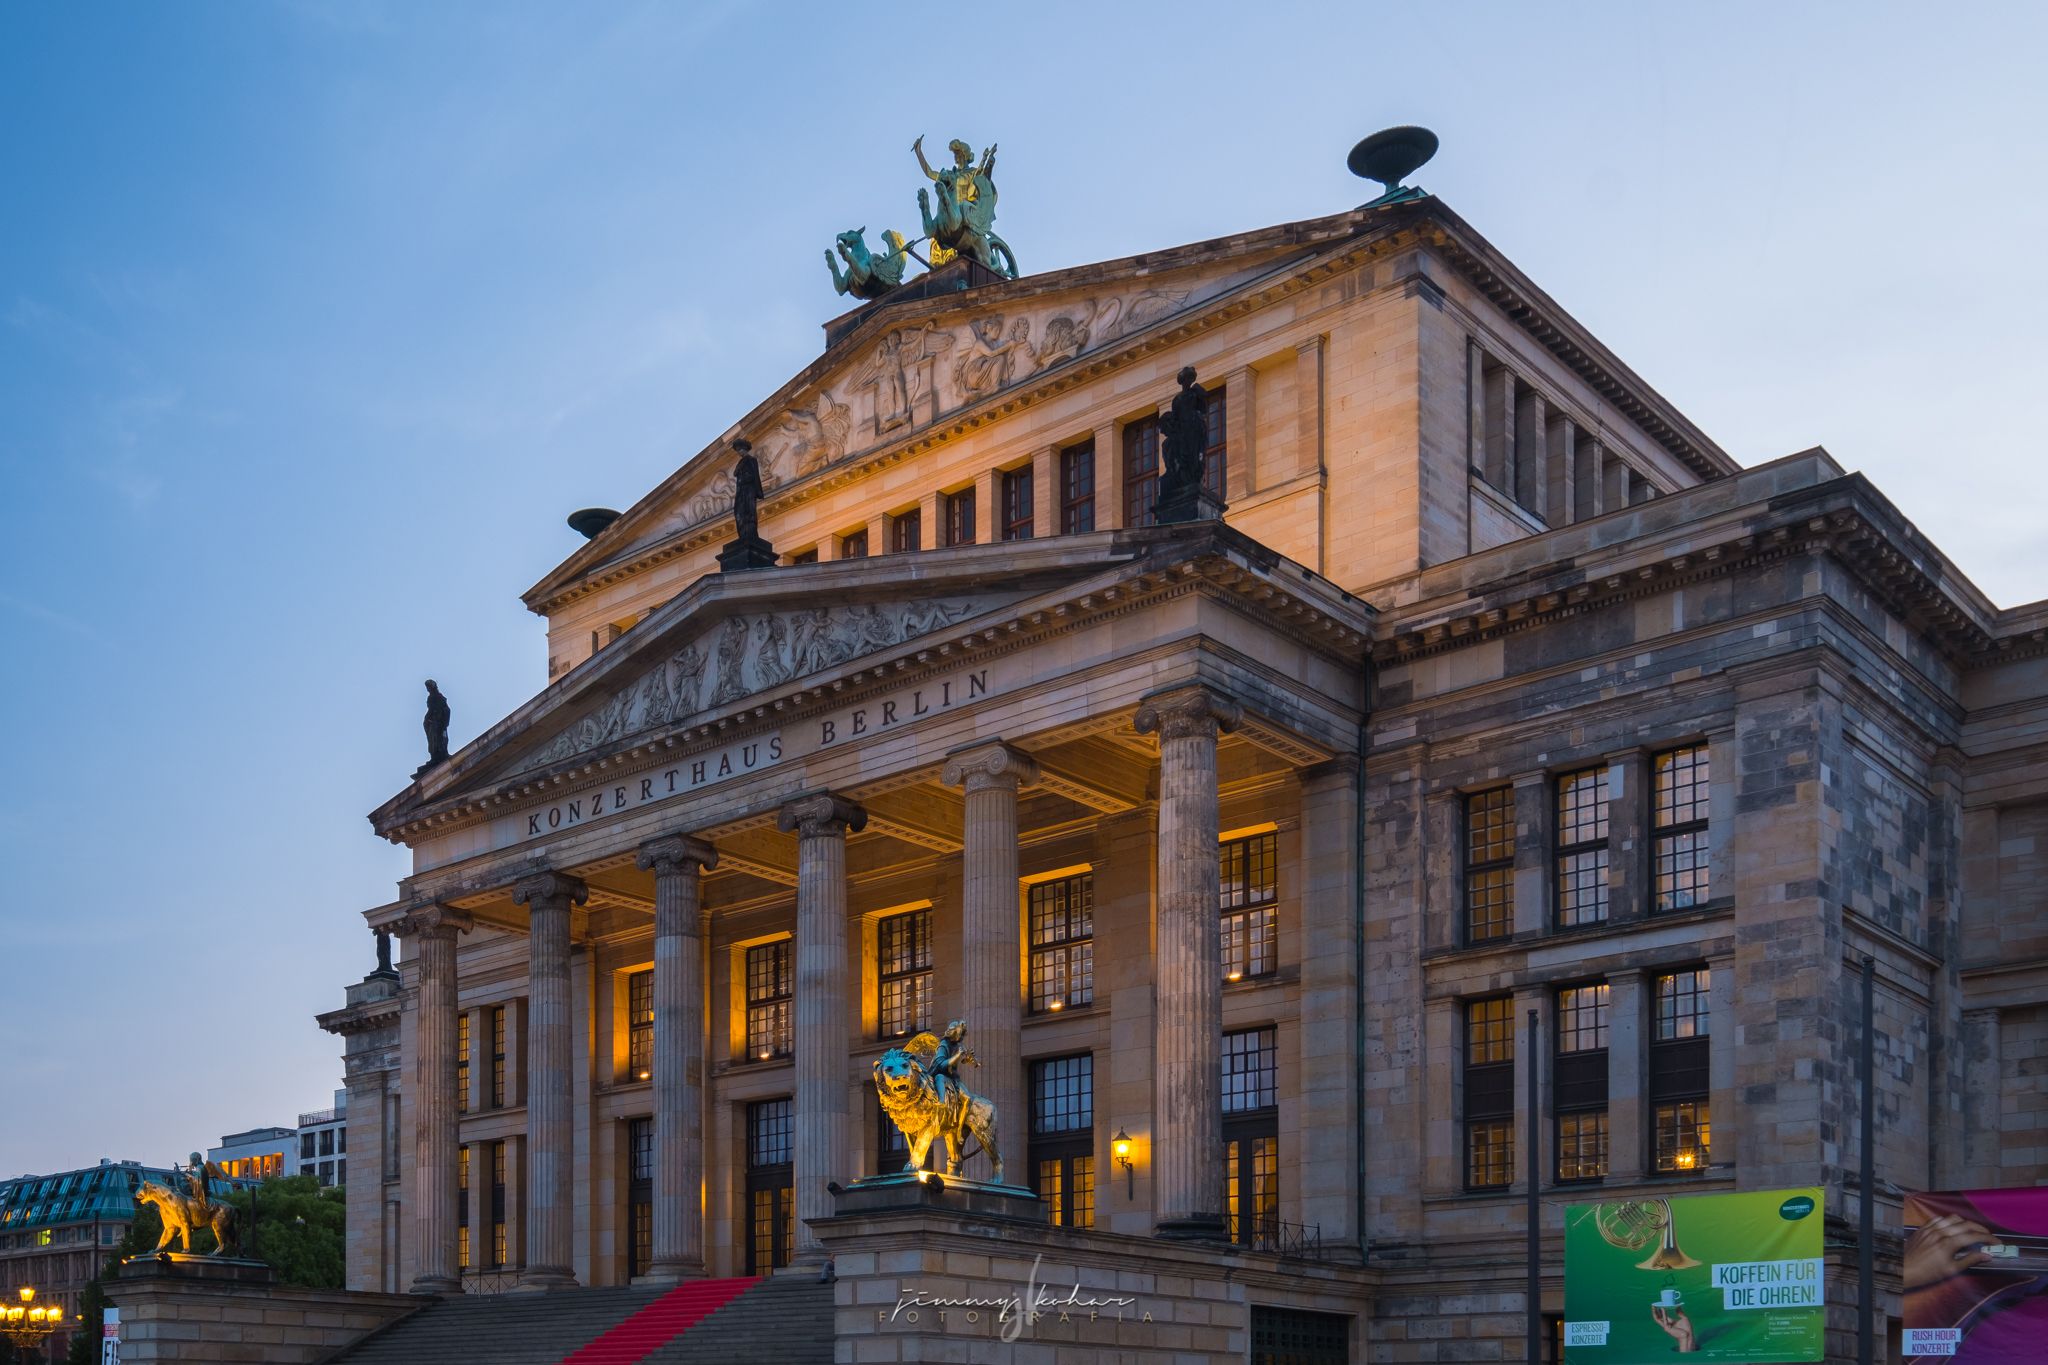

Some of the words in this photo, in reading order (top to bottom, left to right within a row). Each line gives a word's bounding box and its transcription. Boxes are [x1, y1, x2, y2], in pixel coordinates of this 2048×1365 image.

[527, 736, 783, 836] KONZERTHAUS
[820, 669, 989, 746] BERLIN
[1720, 1263, 1781, 1285] KOFFEIN
[1786, 1258, 1816, 1281] FÜR
[1732, 1288, 1755, 1306] DIE
[1760, 1285, 1816, 1305] OHREN!
[1571, 1322, 1606, 1333] ESPRESSO-
[1571, 1334, 1604, 1345] KONZERTE
[1912, 1330, 1934, 1341] RUSH
[1935, 1330, 1957, 1340] HOUR
[1912, 1342, 1951, 1354] KONZERTE
